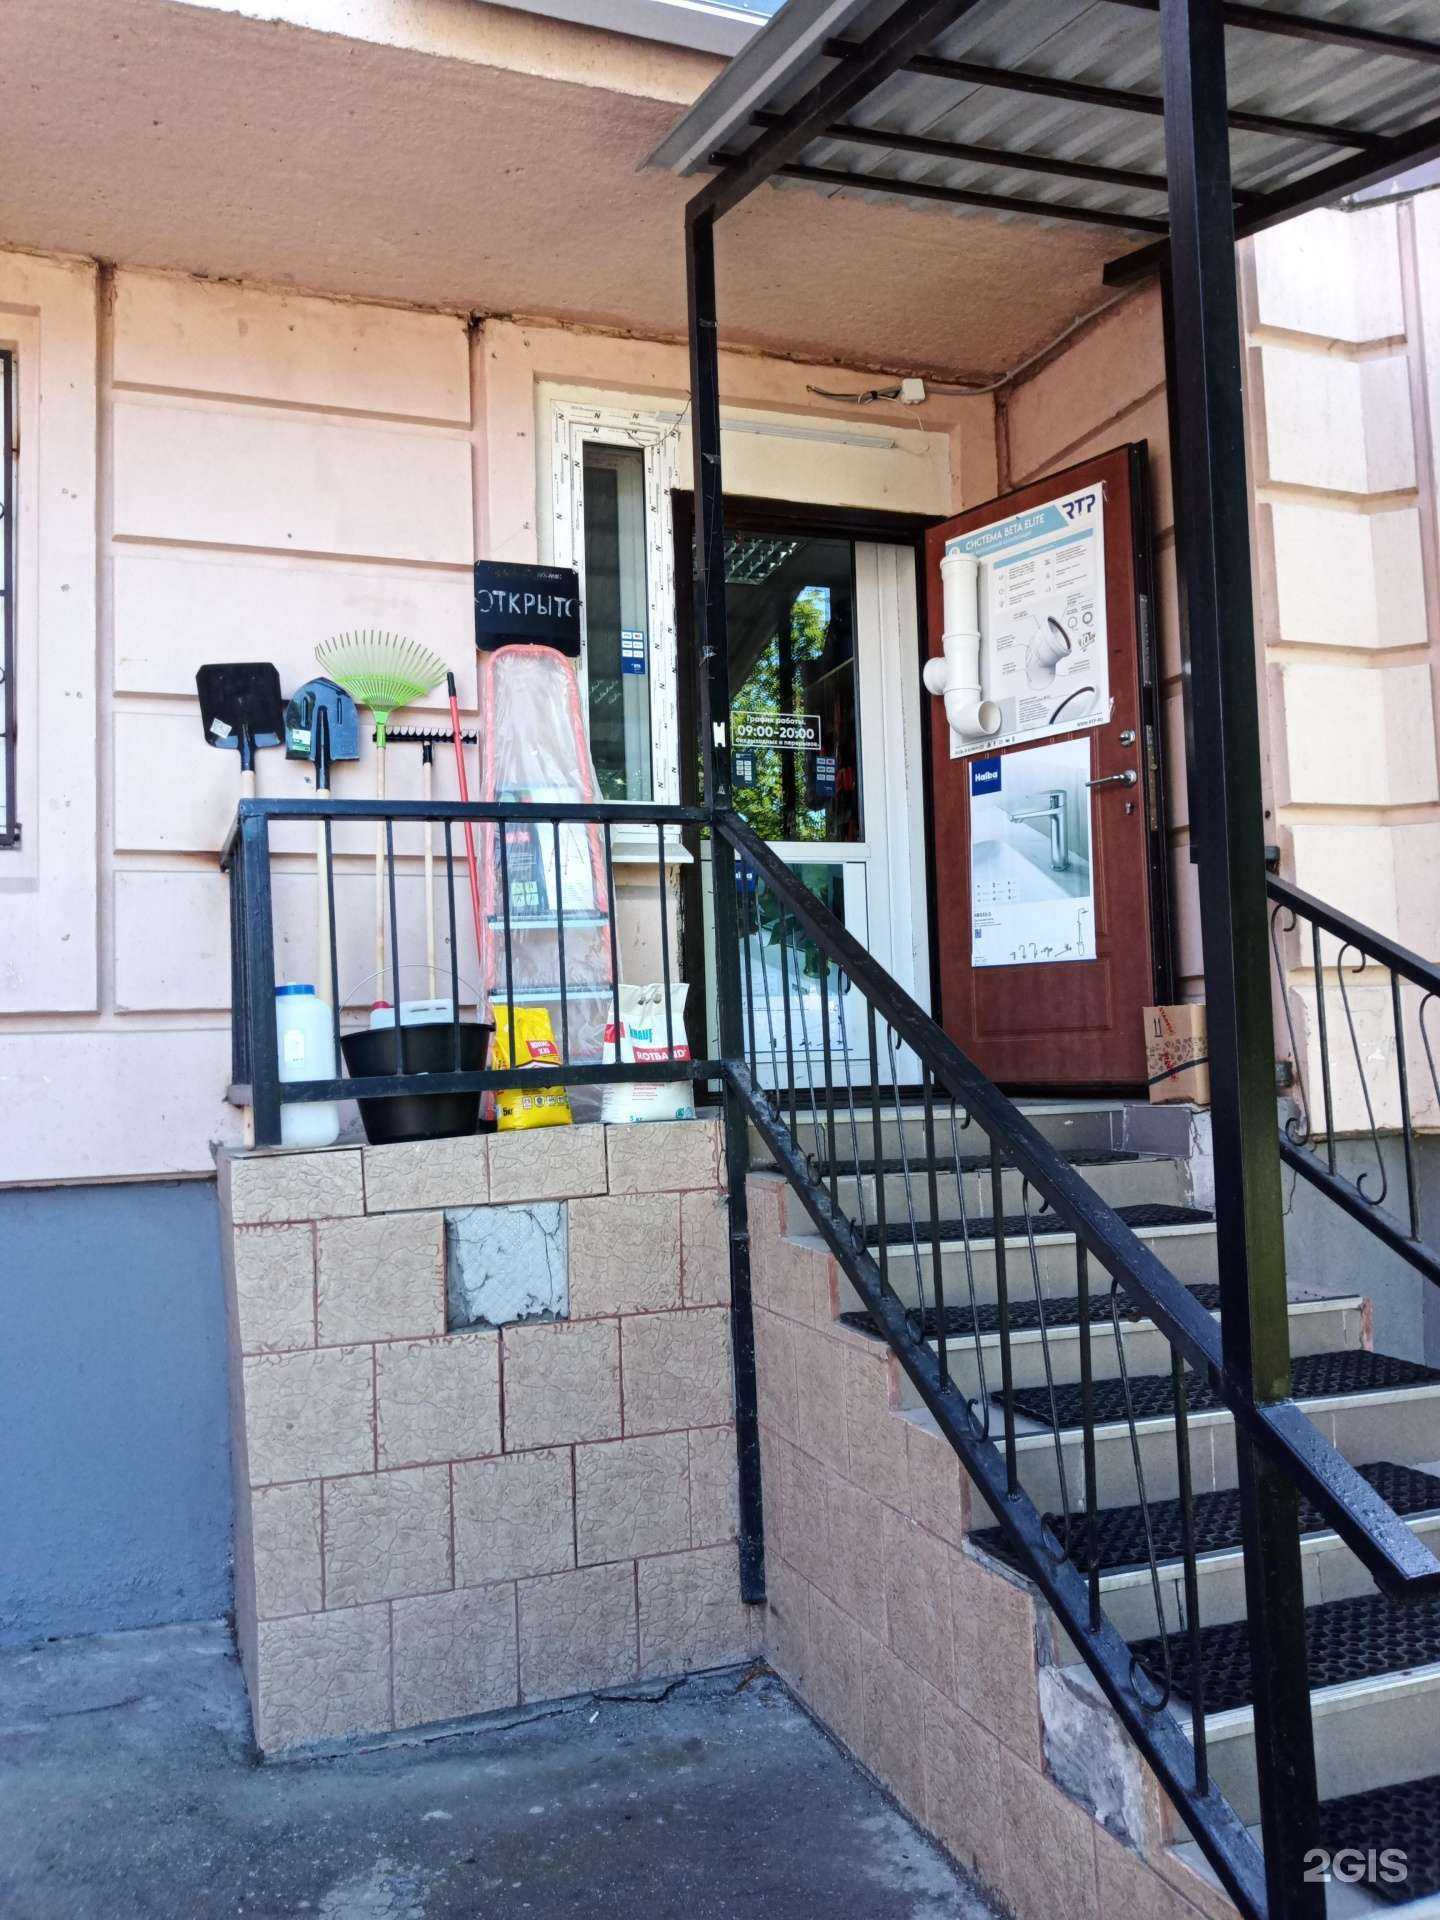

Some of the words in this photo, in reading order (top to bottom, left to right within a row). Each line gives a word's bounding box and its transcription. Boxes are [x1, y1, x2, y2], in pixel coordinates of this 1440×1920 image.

[1062, 494, 1095, 519] RTP
[966, 531, 1002, 551] СИСТЕМА
[1003, 522, 1024, 538] BETA
[1024, 512, 1045, 530] ELITE
[746, 715, 773, 724] График
[737, 724, 815, 739] 09:00-20:00
